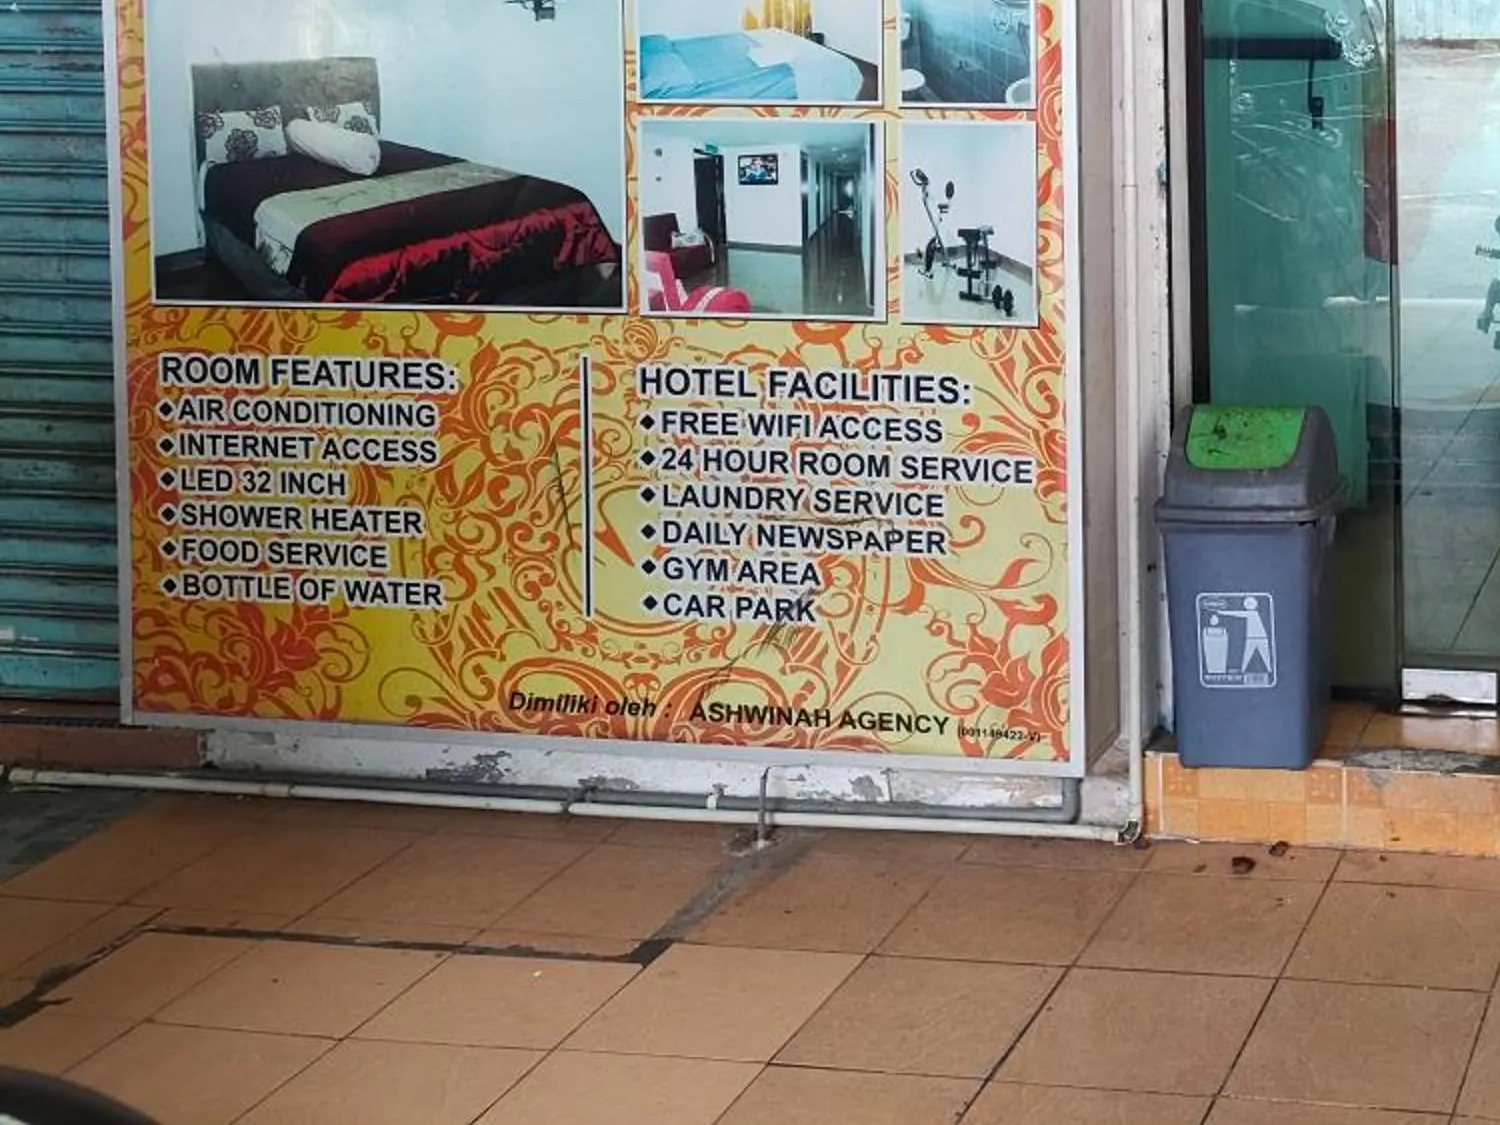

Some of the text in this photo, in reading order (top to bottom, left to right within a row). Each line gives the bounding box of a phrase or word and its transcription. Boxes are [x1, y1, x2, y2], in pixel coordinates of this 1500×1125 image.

[161, 356, 457, 391] ROOM FEATURES:
[639, 369, 971, 404] HOTEL FACILITIES:
[178, 400, 437, 428] AIR CONDITIONING
[661, 411, 943, 443] FREE WIFI ACCESS
[179, 436, 438, 463] INTERNET ACCESS
[661, 448, 1033, 484] 24 HOUR ROOM SERVICE
[181, 470, 346, 495] LED 32 INCH
[663, 484, 945, 517] LAUNDRY SERVICE
[181, 504, 422, 535] SHOWER HEATER
[663, 520, 947, 554] DAILY NEWSPAPER
[182, 540, 388, 568] FOOD SERVICE
[663, 556, 820, 586] GYM AREA
[183, 575, 443, 606] BOTTLE OF WATER
[663, 593, 816, 622] CAR PARK
[509, 691, 598, 717] Dimiliki
[605, 696, 656, 718] oleh
[689, 701, 832, 731] ASHWINAH
[840, 708, 951, 736] AGENCY
